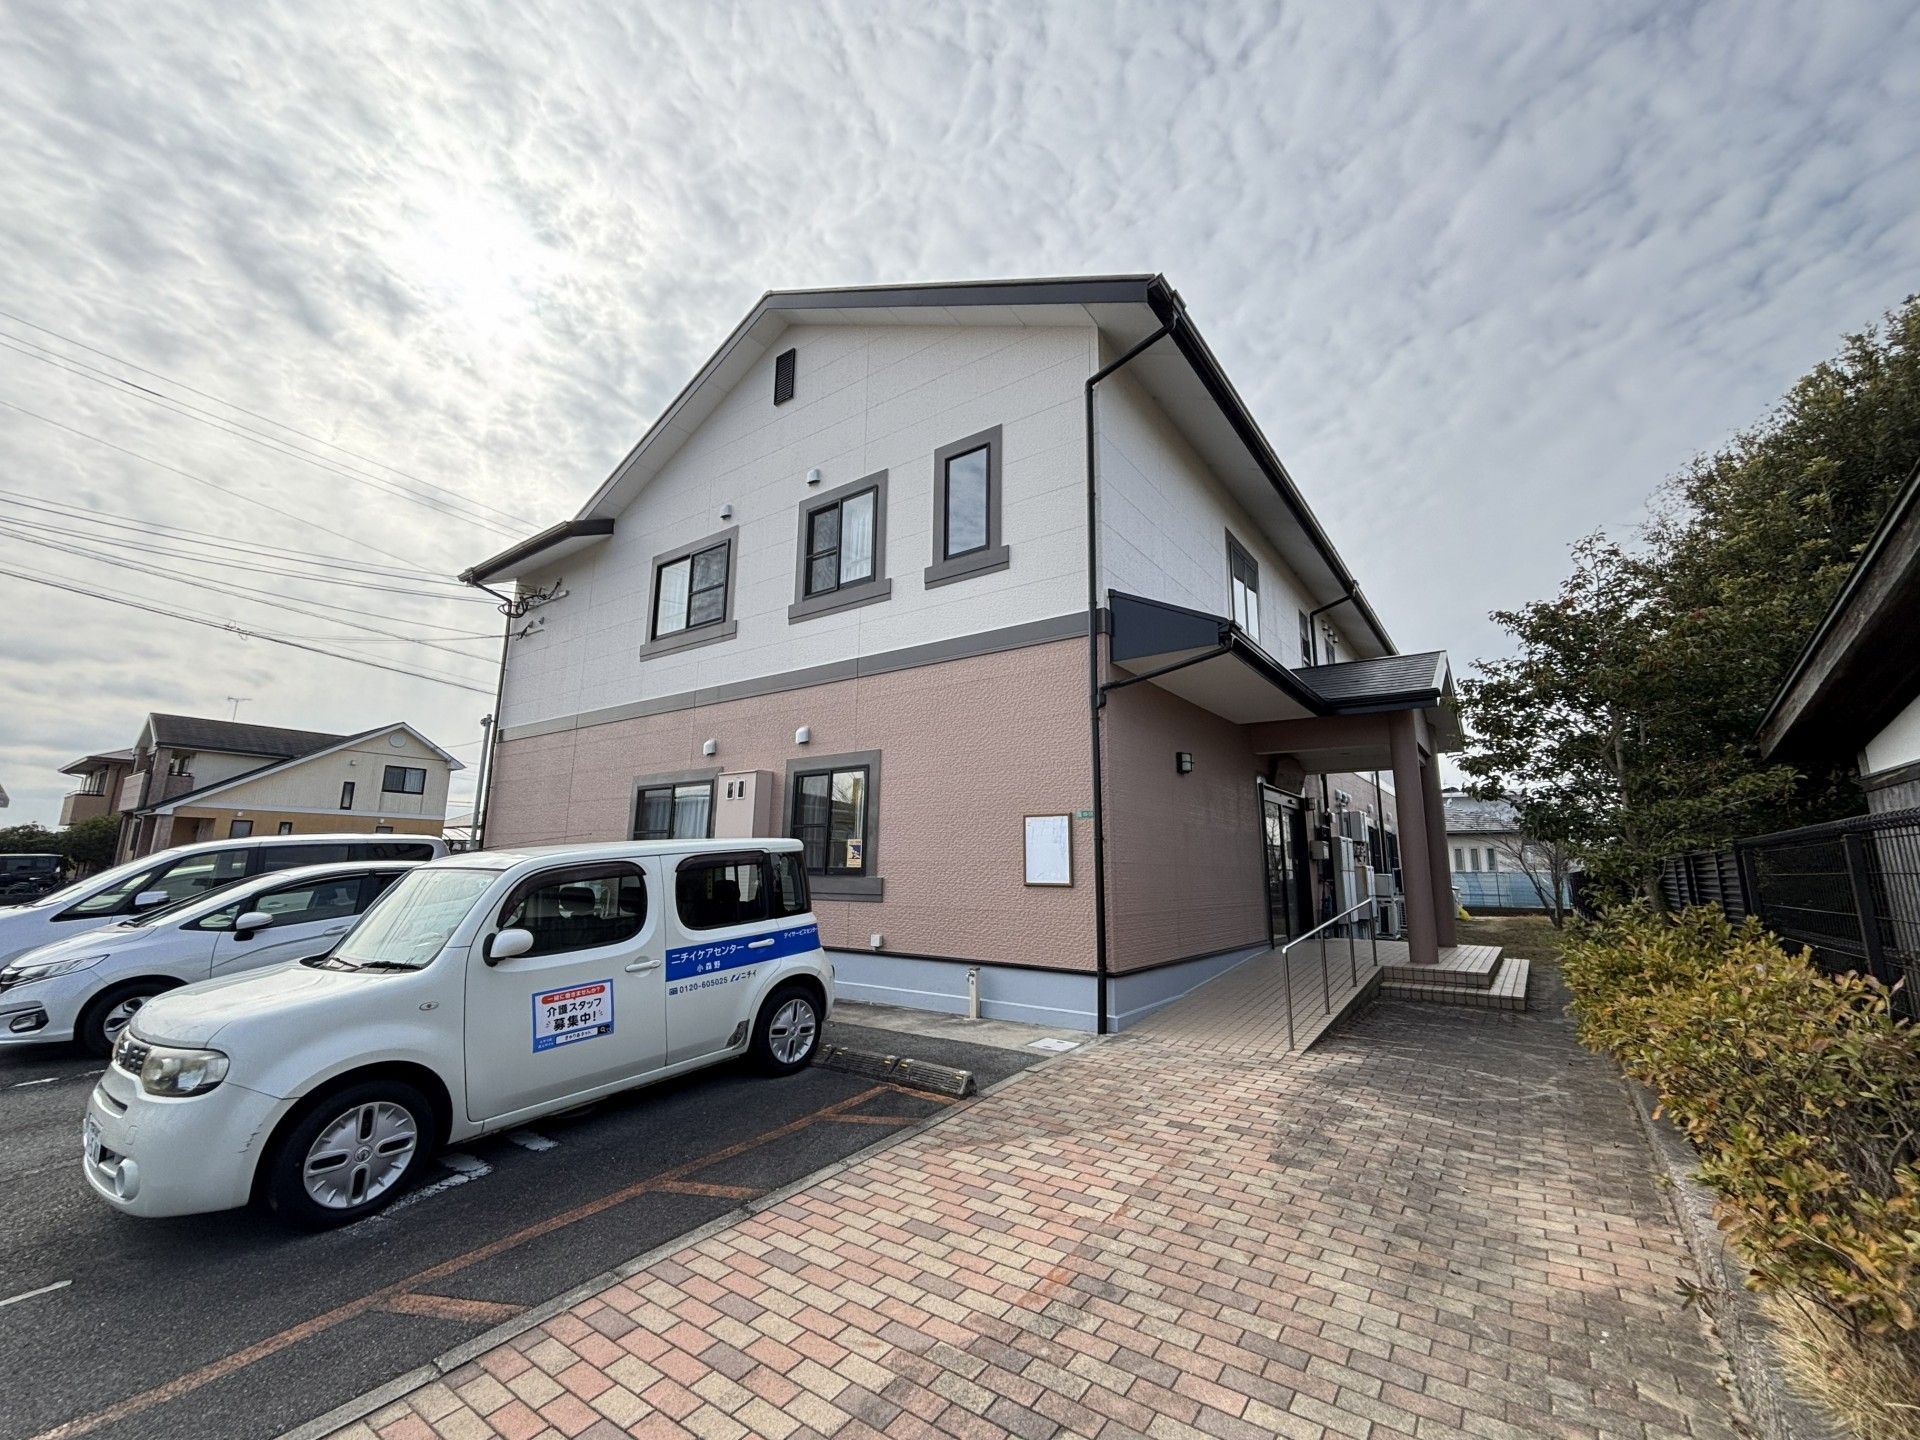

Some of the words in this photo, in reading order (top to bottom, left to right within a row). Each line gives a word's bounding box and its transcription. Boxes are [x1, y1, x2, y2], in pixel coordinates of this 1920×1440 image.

[671, 944, 745, 965] ニチイケアセンター
[741, 969, 757, 979] ニチイ
[546, 997, 602, 1018] 介護スタッフ
[553, 1010, 597, 1032] 募集中!
